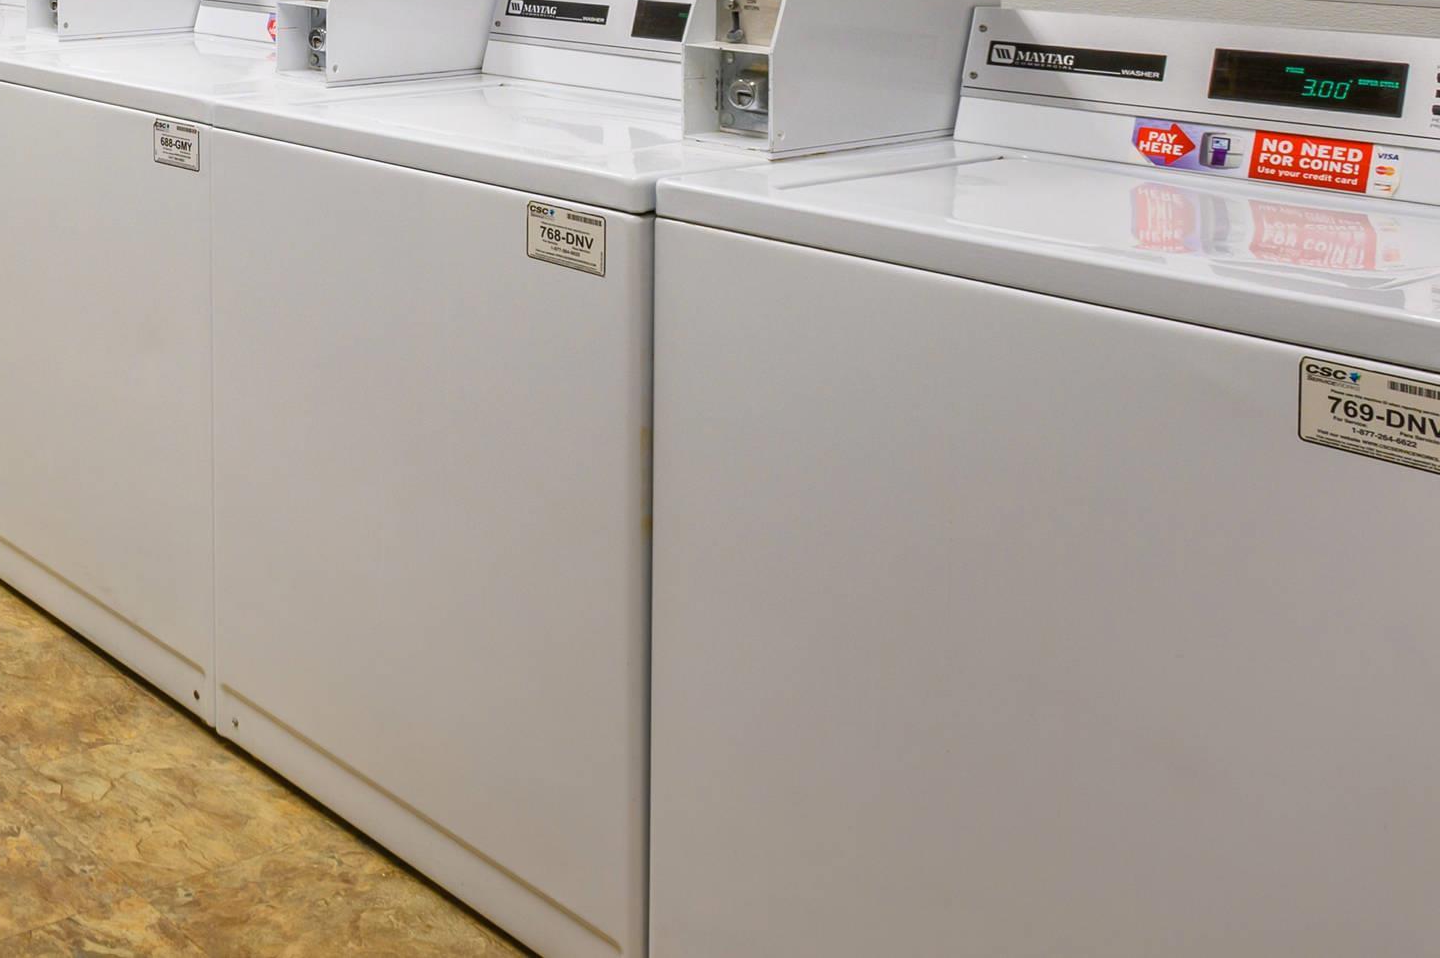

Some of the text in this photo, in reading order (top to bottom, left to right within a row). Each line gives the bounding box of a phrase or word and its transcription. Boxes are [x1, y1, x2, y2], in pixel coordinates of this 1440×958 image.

[523, 4, 557, 15] MAYTAG
[1016, 50, 1075, 66] MAYTAG
[1121, 69, 1160, 79] WASHER
[1148, 131, 1178, 143] PAY
[1139, 140, 1184, 156] HERE
[1262, 138, 1364, 162] NO NEED
[1259, 153, 1360, 175] FOR COINS!
[1377, 153, 1400, 161] VISA
[1257, 166, 1358, 185] Use your credit card
[530, 205, 549, 215] CSC
[540, 226, 594, 249] 768-DNV
[1306, 364, 1347, 381] CSC
